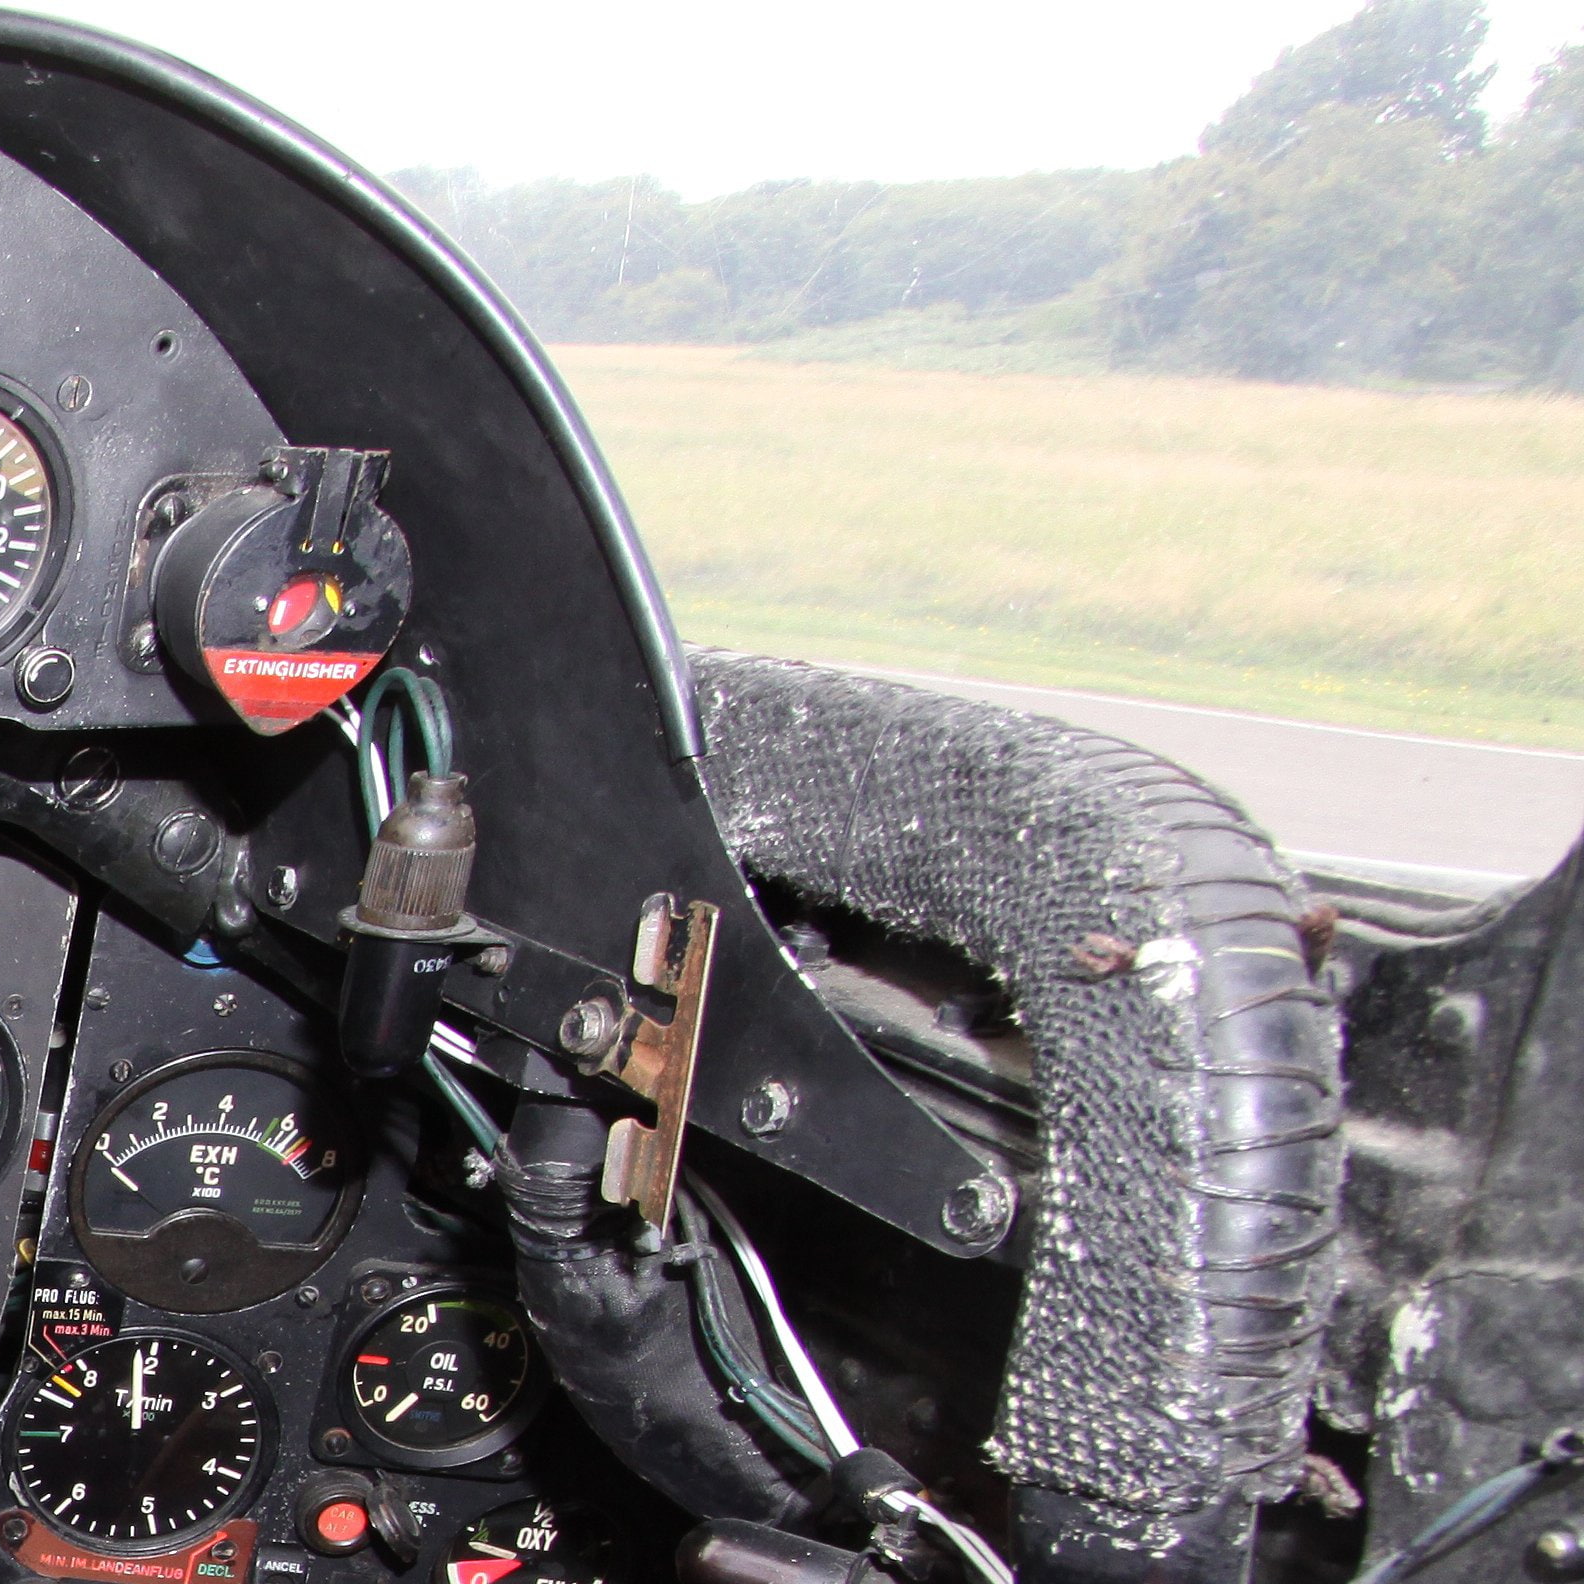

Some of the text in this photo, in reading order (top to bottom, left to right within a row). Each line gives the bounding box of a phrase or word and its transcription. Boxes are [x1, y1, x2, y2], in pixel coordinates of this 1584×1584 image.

[222, 658, 358, 681] EXTINGUISHER
[190, 1144, 239, 1165] EXH
[33, 1288, 101, 1305] PRO FLUG:
[430, 1352, 459, 1372] OIL
[516, 1526, 558, 1552] OXY
